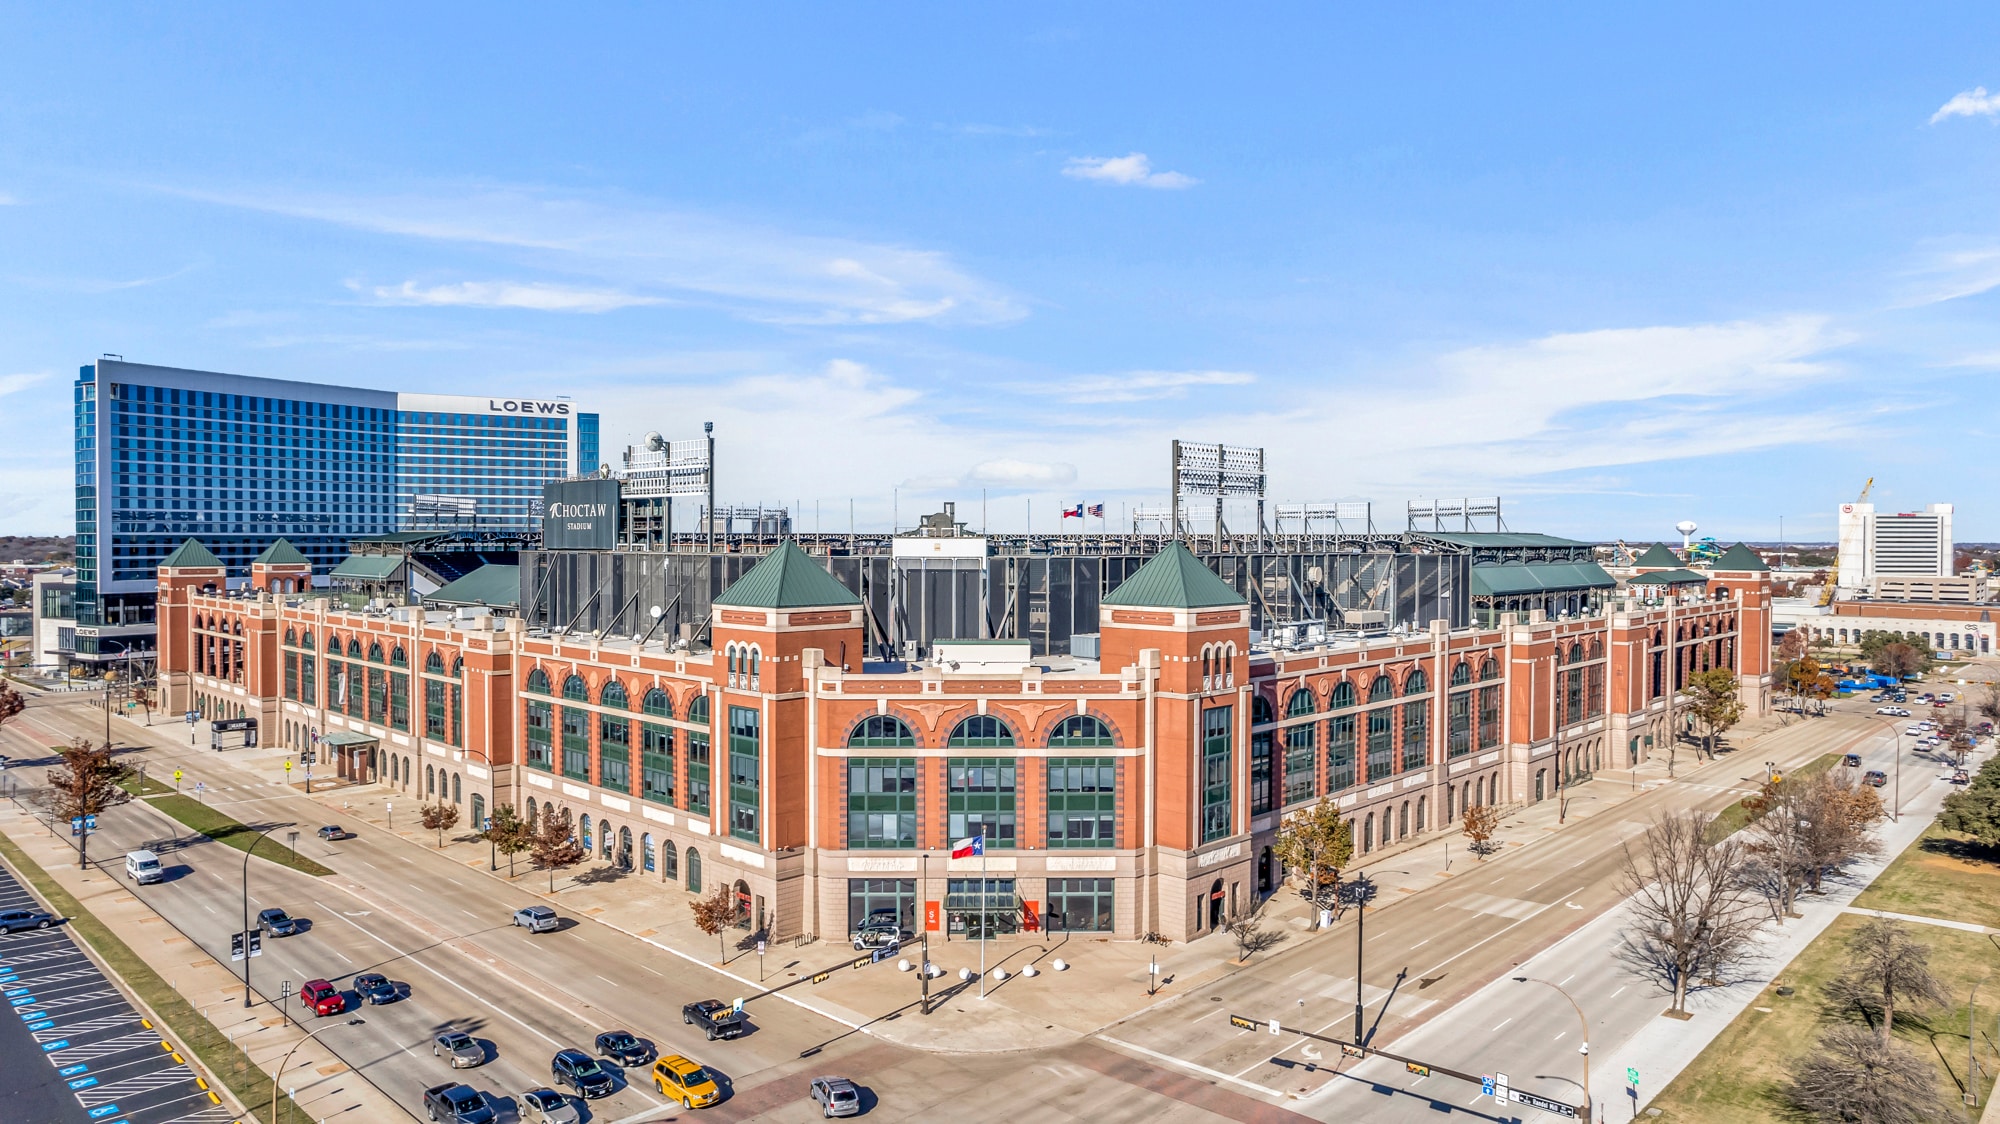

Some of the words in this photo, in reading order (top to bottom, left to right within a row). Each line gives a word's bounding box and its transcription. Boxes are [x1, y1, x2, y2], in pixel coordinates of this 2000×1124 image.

[490, 400, 570, 414] LOEWS
[552, 502, 606, 518] CHOCTAW
[567, 522, 592, 530] STADIUM
